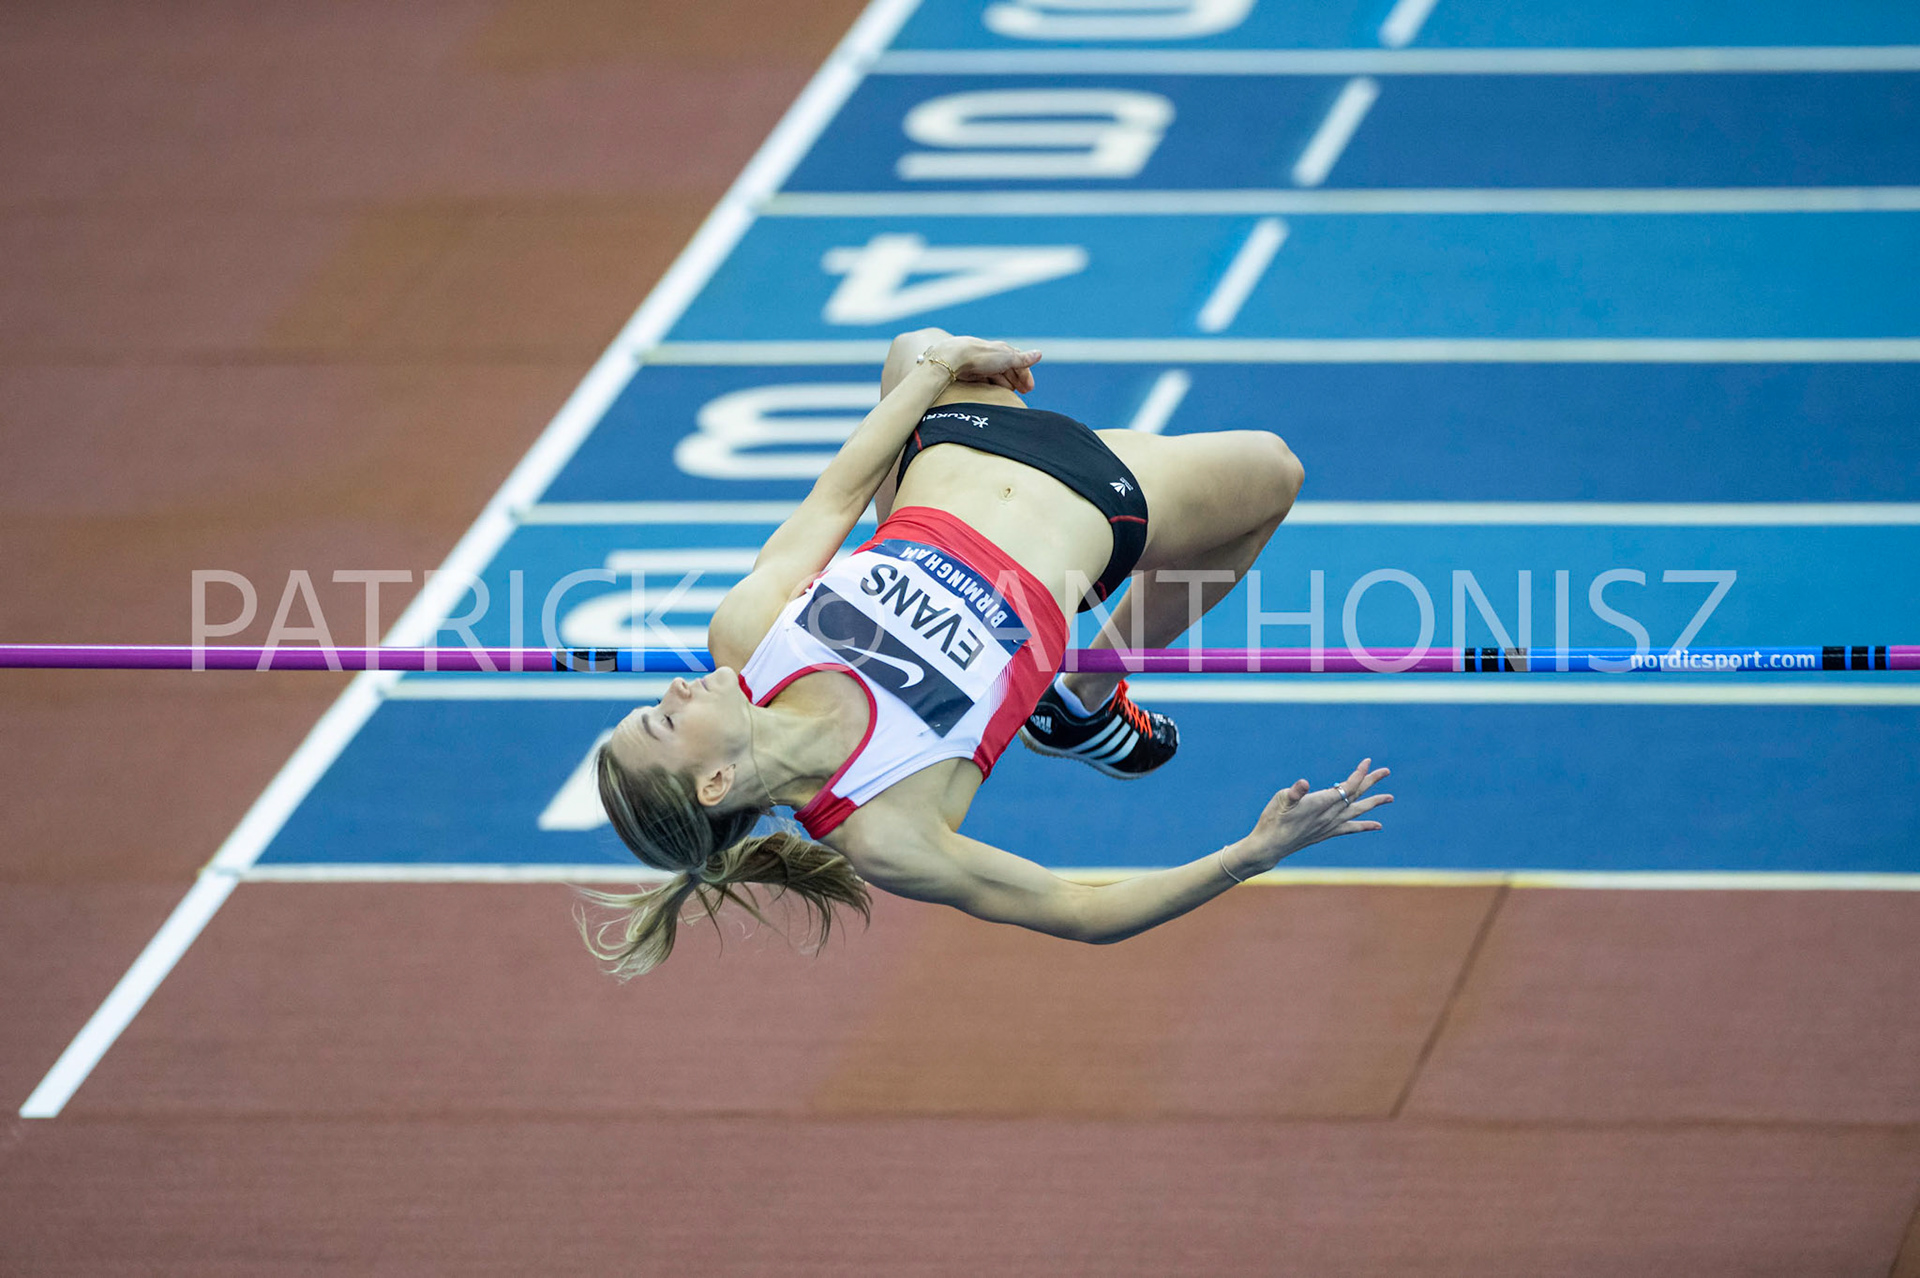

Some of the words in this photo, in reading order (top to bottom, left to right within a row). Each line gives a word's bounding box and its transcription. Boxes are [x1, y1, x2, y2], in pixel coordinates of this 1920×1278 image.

[820, 232, 1090, 327] 4
[859, 563, 985, 671] EVANS
[899, 546, 1009, 629] BIRMINGHAM
[1630, 649, 1816, 671] nordicsport.com
